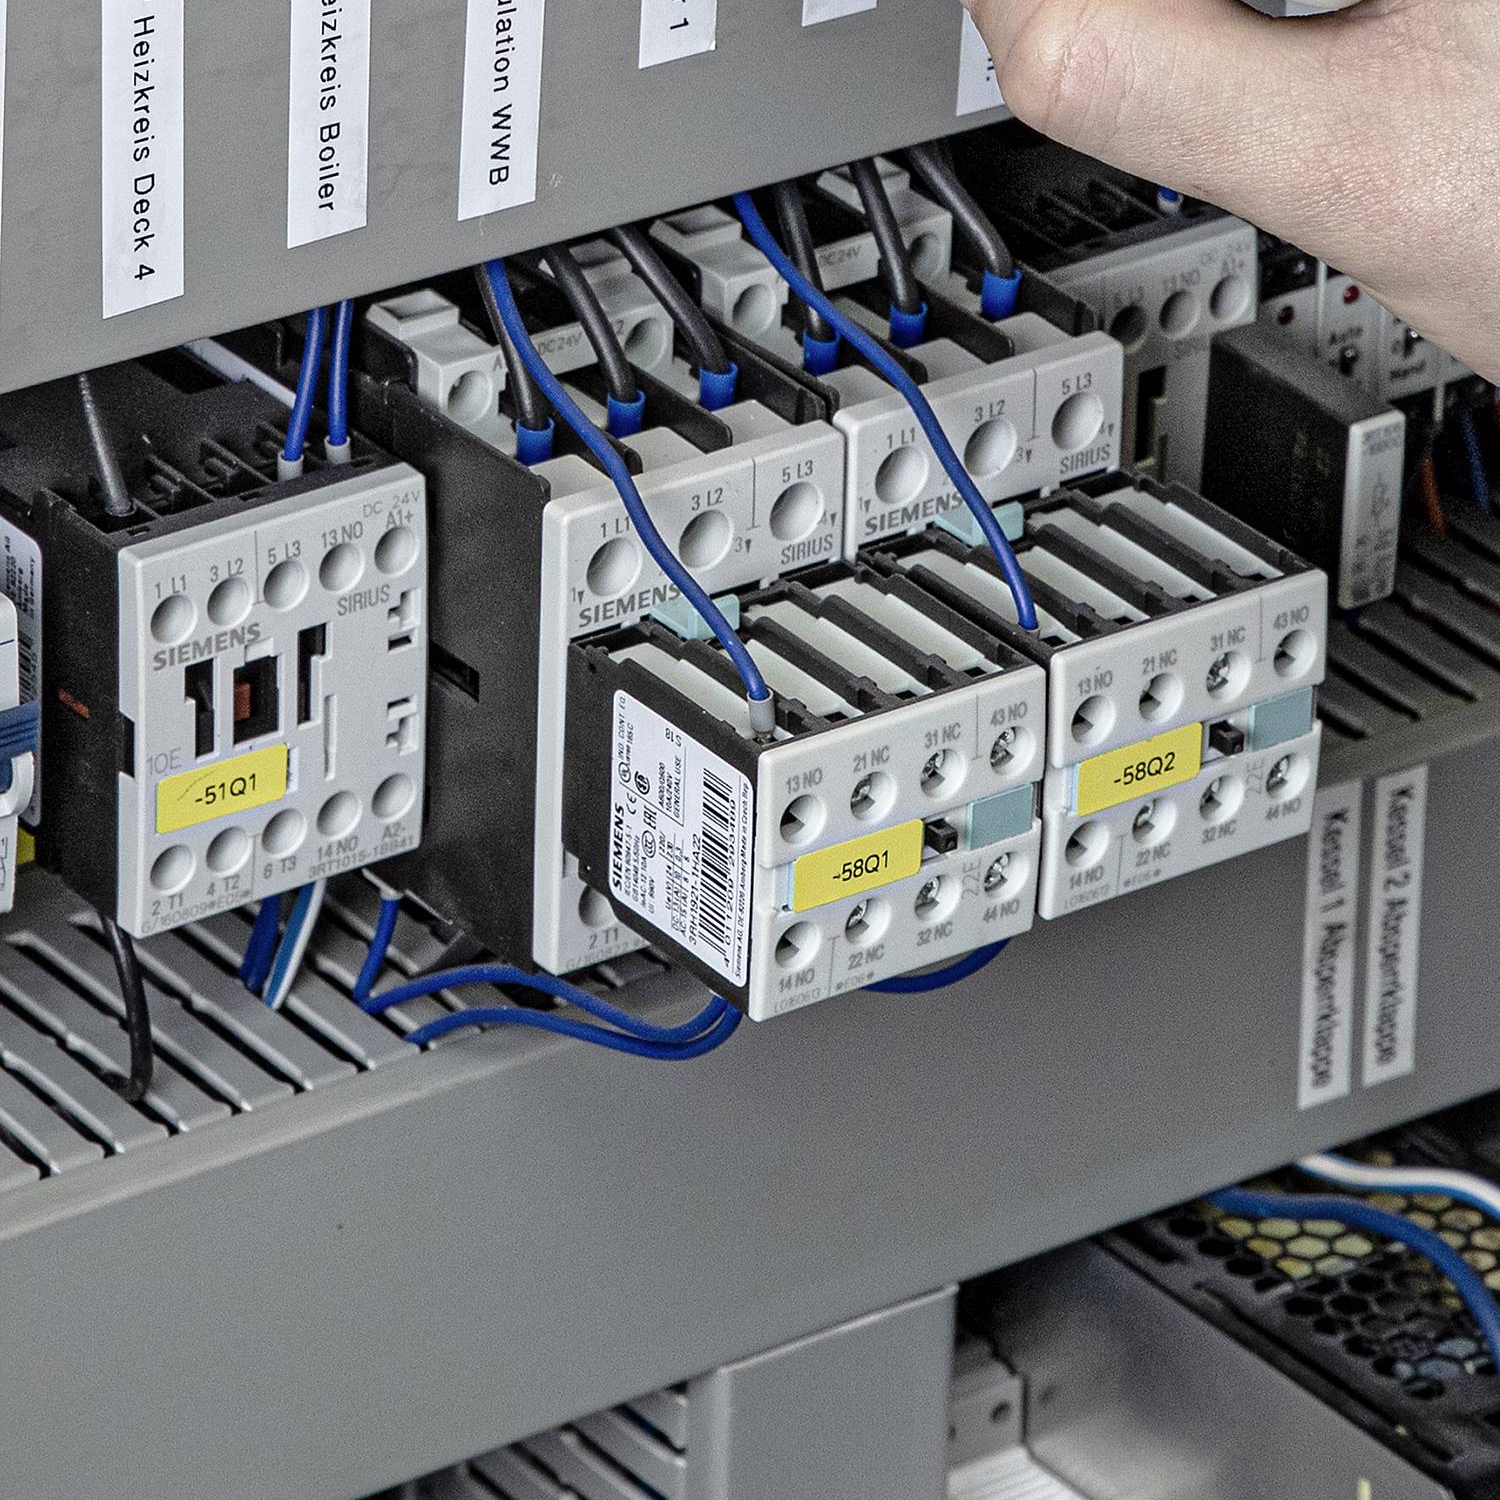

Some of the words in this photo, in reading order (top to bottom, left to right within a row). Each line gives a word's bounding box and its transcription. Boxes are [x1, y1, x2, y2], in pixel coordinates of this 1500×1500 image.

[669, 18, 690, 32] 1
[132, 14, 157, 162] Heizkreis
[488, 103, 513, 187] WWB
[317, 122, 341, 212] Boiler
[132, 174, 156, 253] Deck
[133, 266, 156, 281] 4
[1059, 444, 1111, 475] SIRIUS
[865, 492, 965, 537] SIEMENS
[781, 535, 834, 566] SIRIUS
[337, 585, 391, 617] SIRIUS
[578, 581, 682, 628] SIEMENS
[152, 623, 261, 671] SIEMENS
[195, 773, 257, 806] -51Q1
[1114, 752, 1176, 788] -58Q2
[612, 802, 625, 891] SIEMENS
[832, 850, 890, 884] -58Q1
